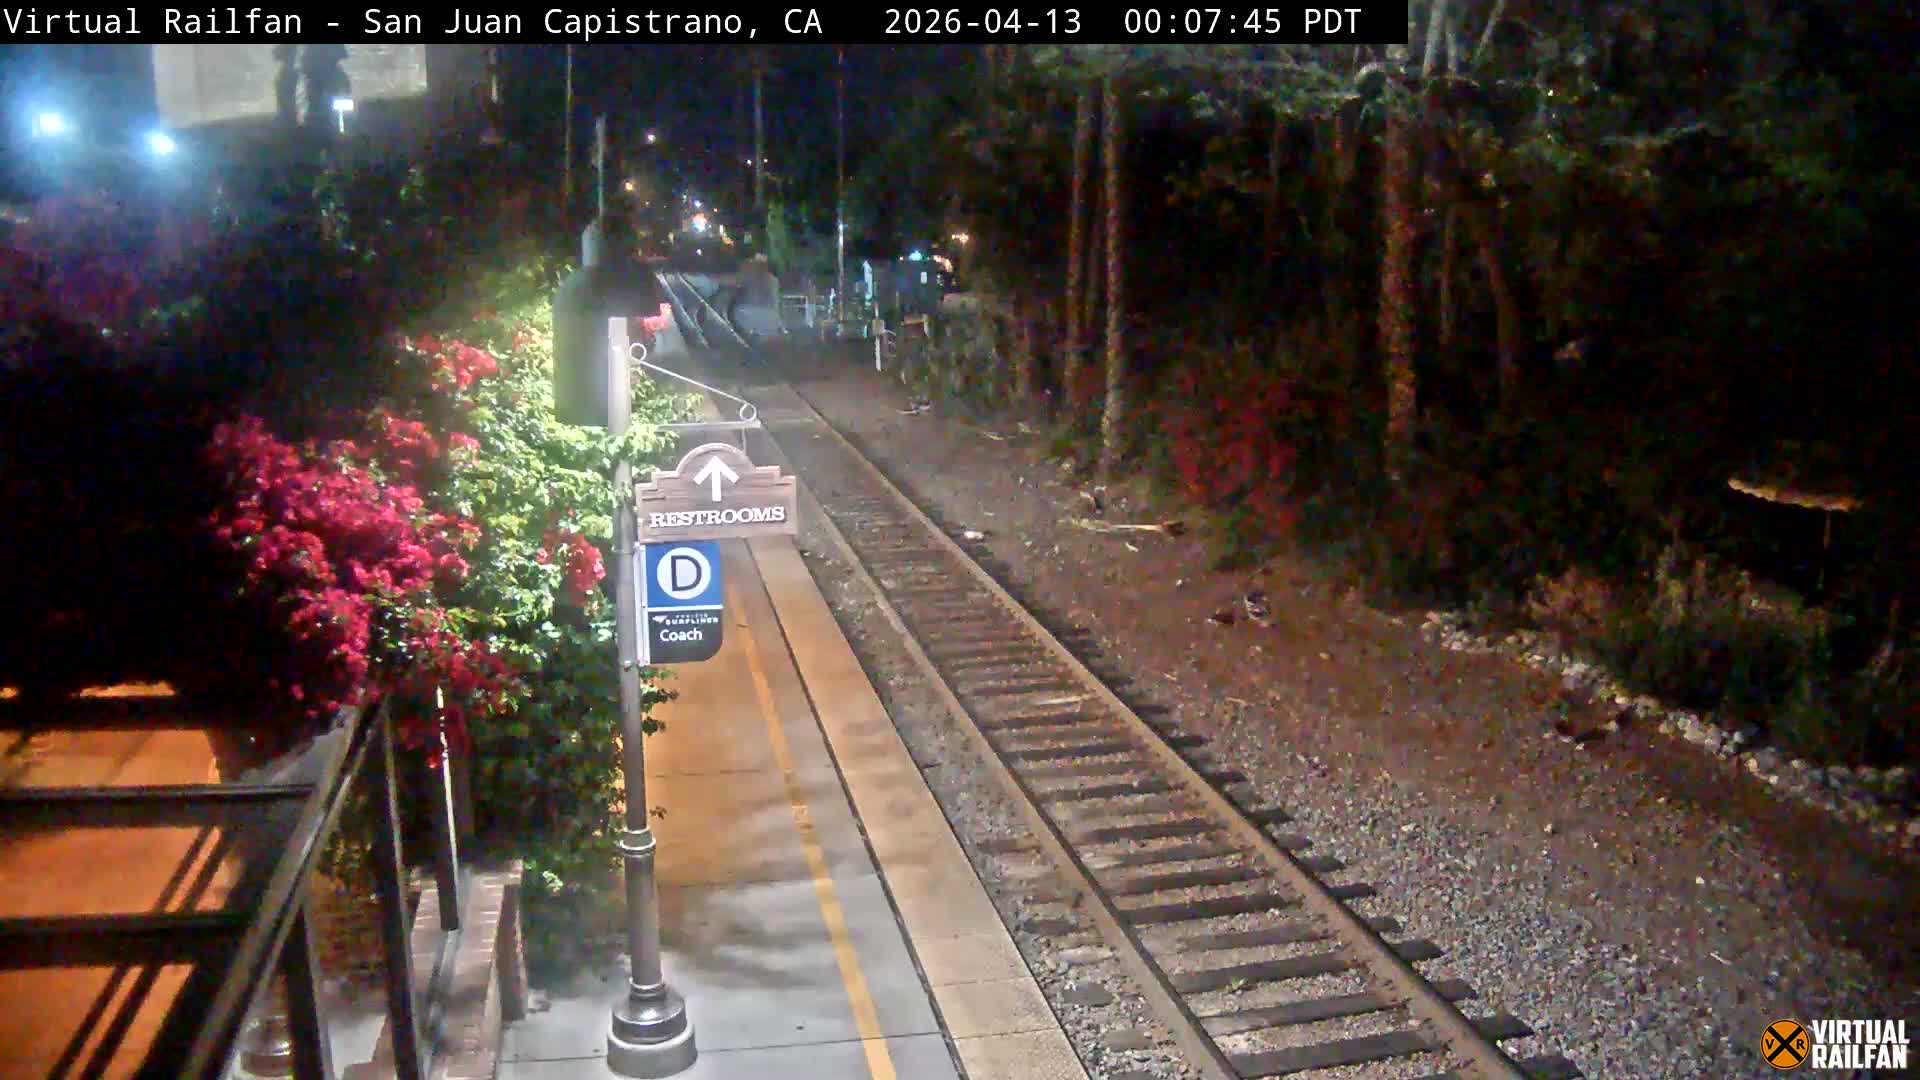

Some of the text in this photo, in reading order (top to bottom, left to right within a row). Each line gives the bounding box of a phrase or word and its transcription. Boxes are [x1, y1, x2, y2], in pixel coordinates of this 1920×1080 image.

[649, 506, 785, 528] RESTROOMS
[671, 555, 702, 592] D
[660, 628, 703, 642] Coach
